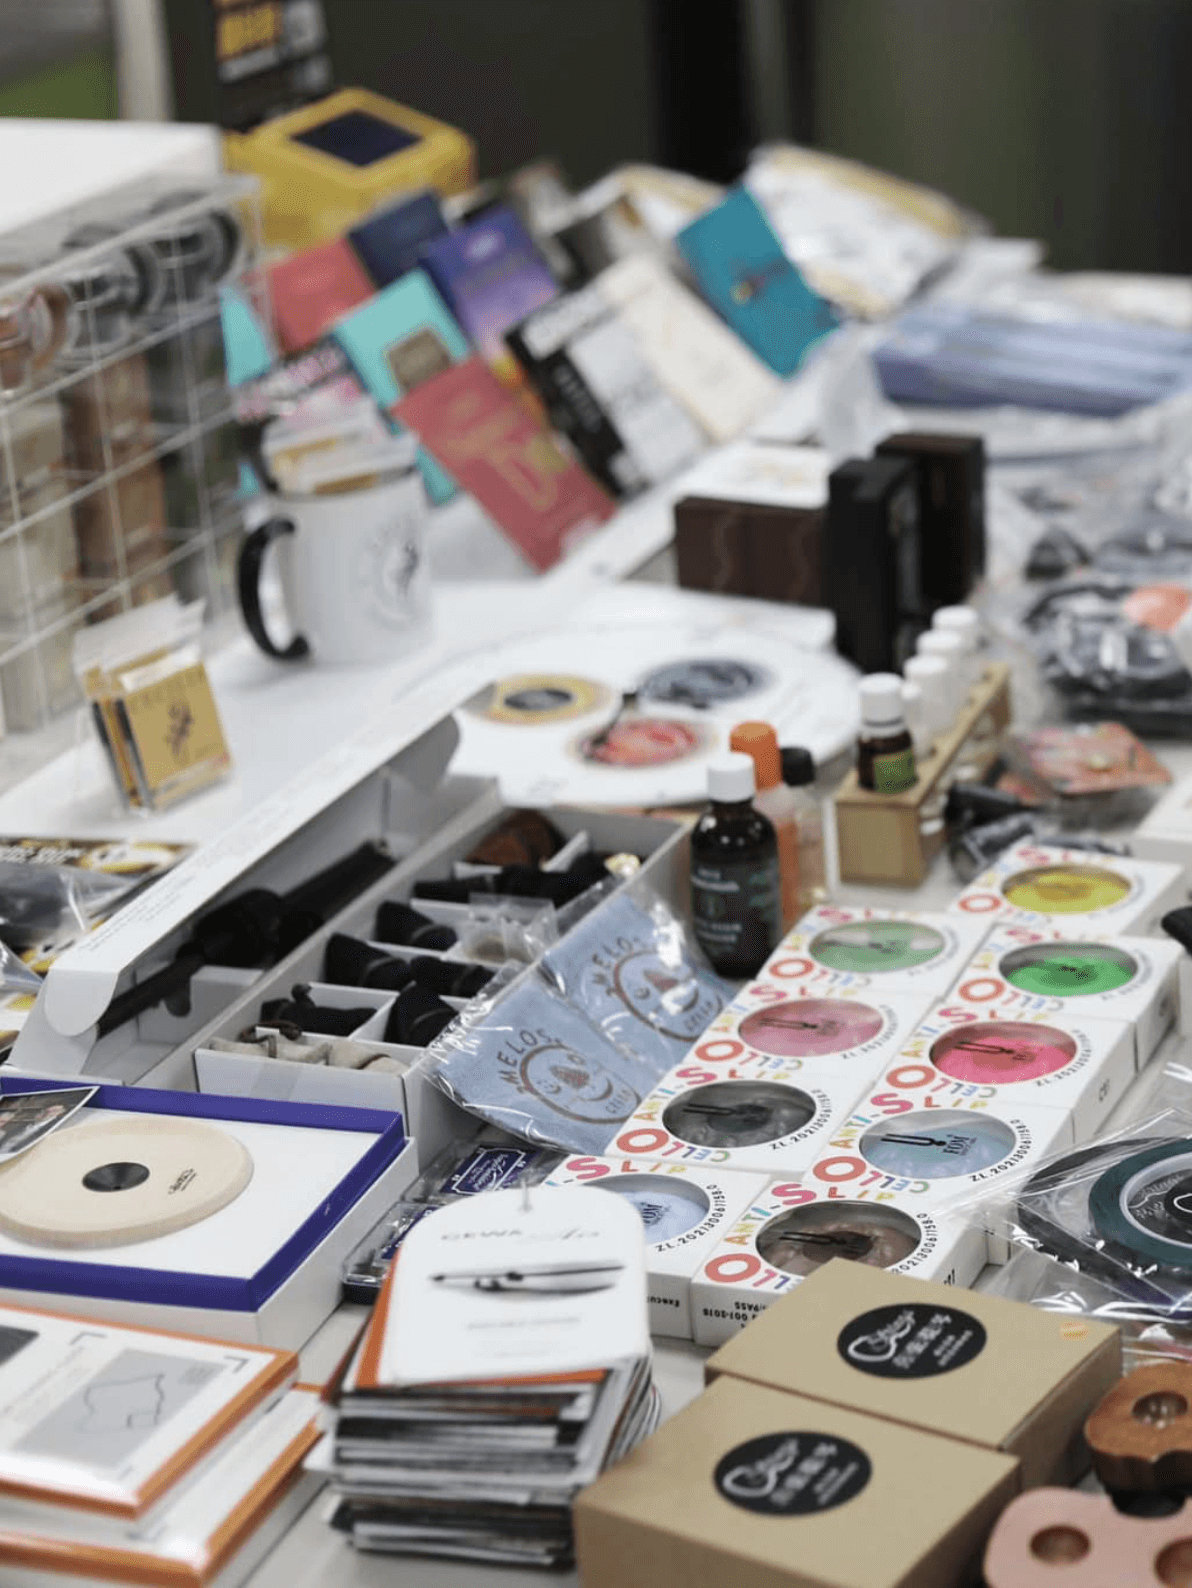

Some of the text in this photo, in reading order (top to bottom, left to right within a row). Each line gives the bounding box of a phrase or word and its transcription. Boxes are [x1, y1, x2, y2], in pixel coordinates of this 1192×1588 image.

[616, 1128, 731, 1163] CELLO
[813, 1155, 930, 1194] CELLO
[647, 1296, 680, 1308] Execu
